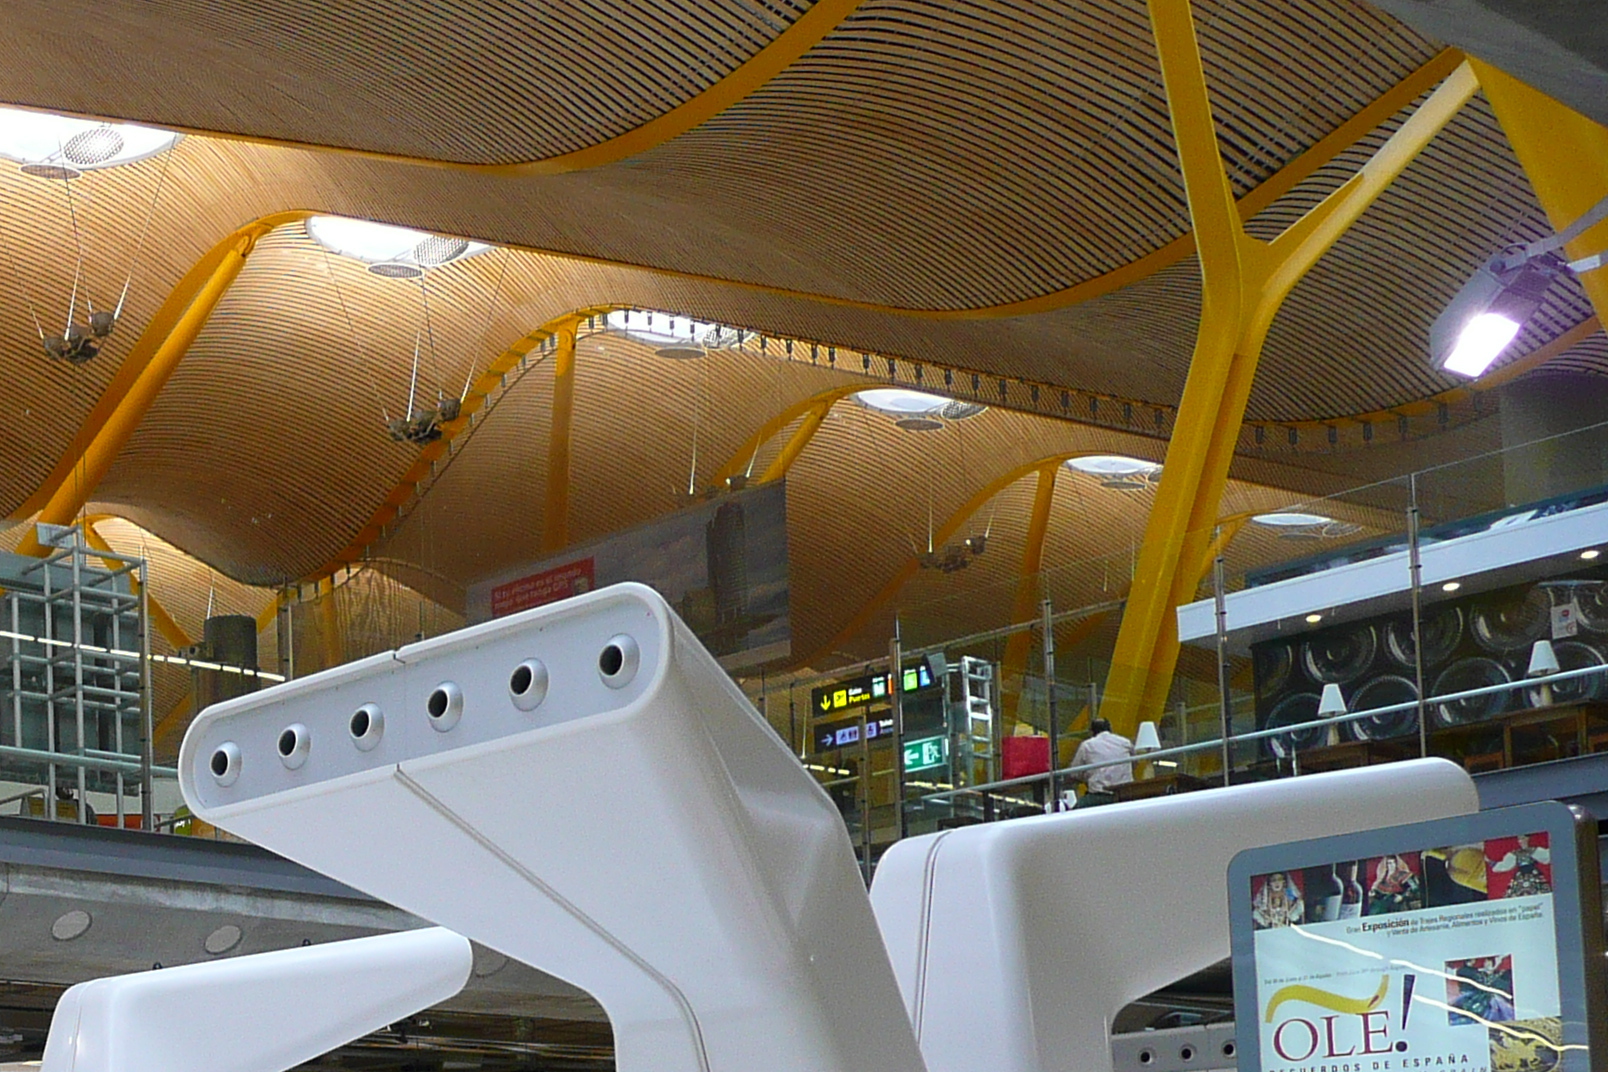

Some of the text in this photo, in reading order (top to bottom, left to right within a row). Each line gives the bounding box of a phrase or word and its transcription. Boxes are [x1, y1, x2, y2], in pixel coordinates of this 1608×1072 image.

[1362, 917, 1409, 933] Exposición
[1372, 1061, 1390, 1070] DE
[1402, 1054, 1469, 1068] ESPAÑA
